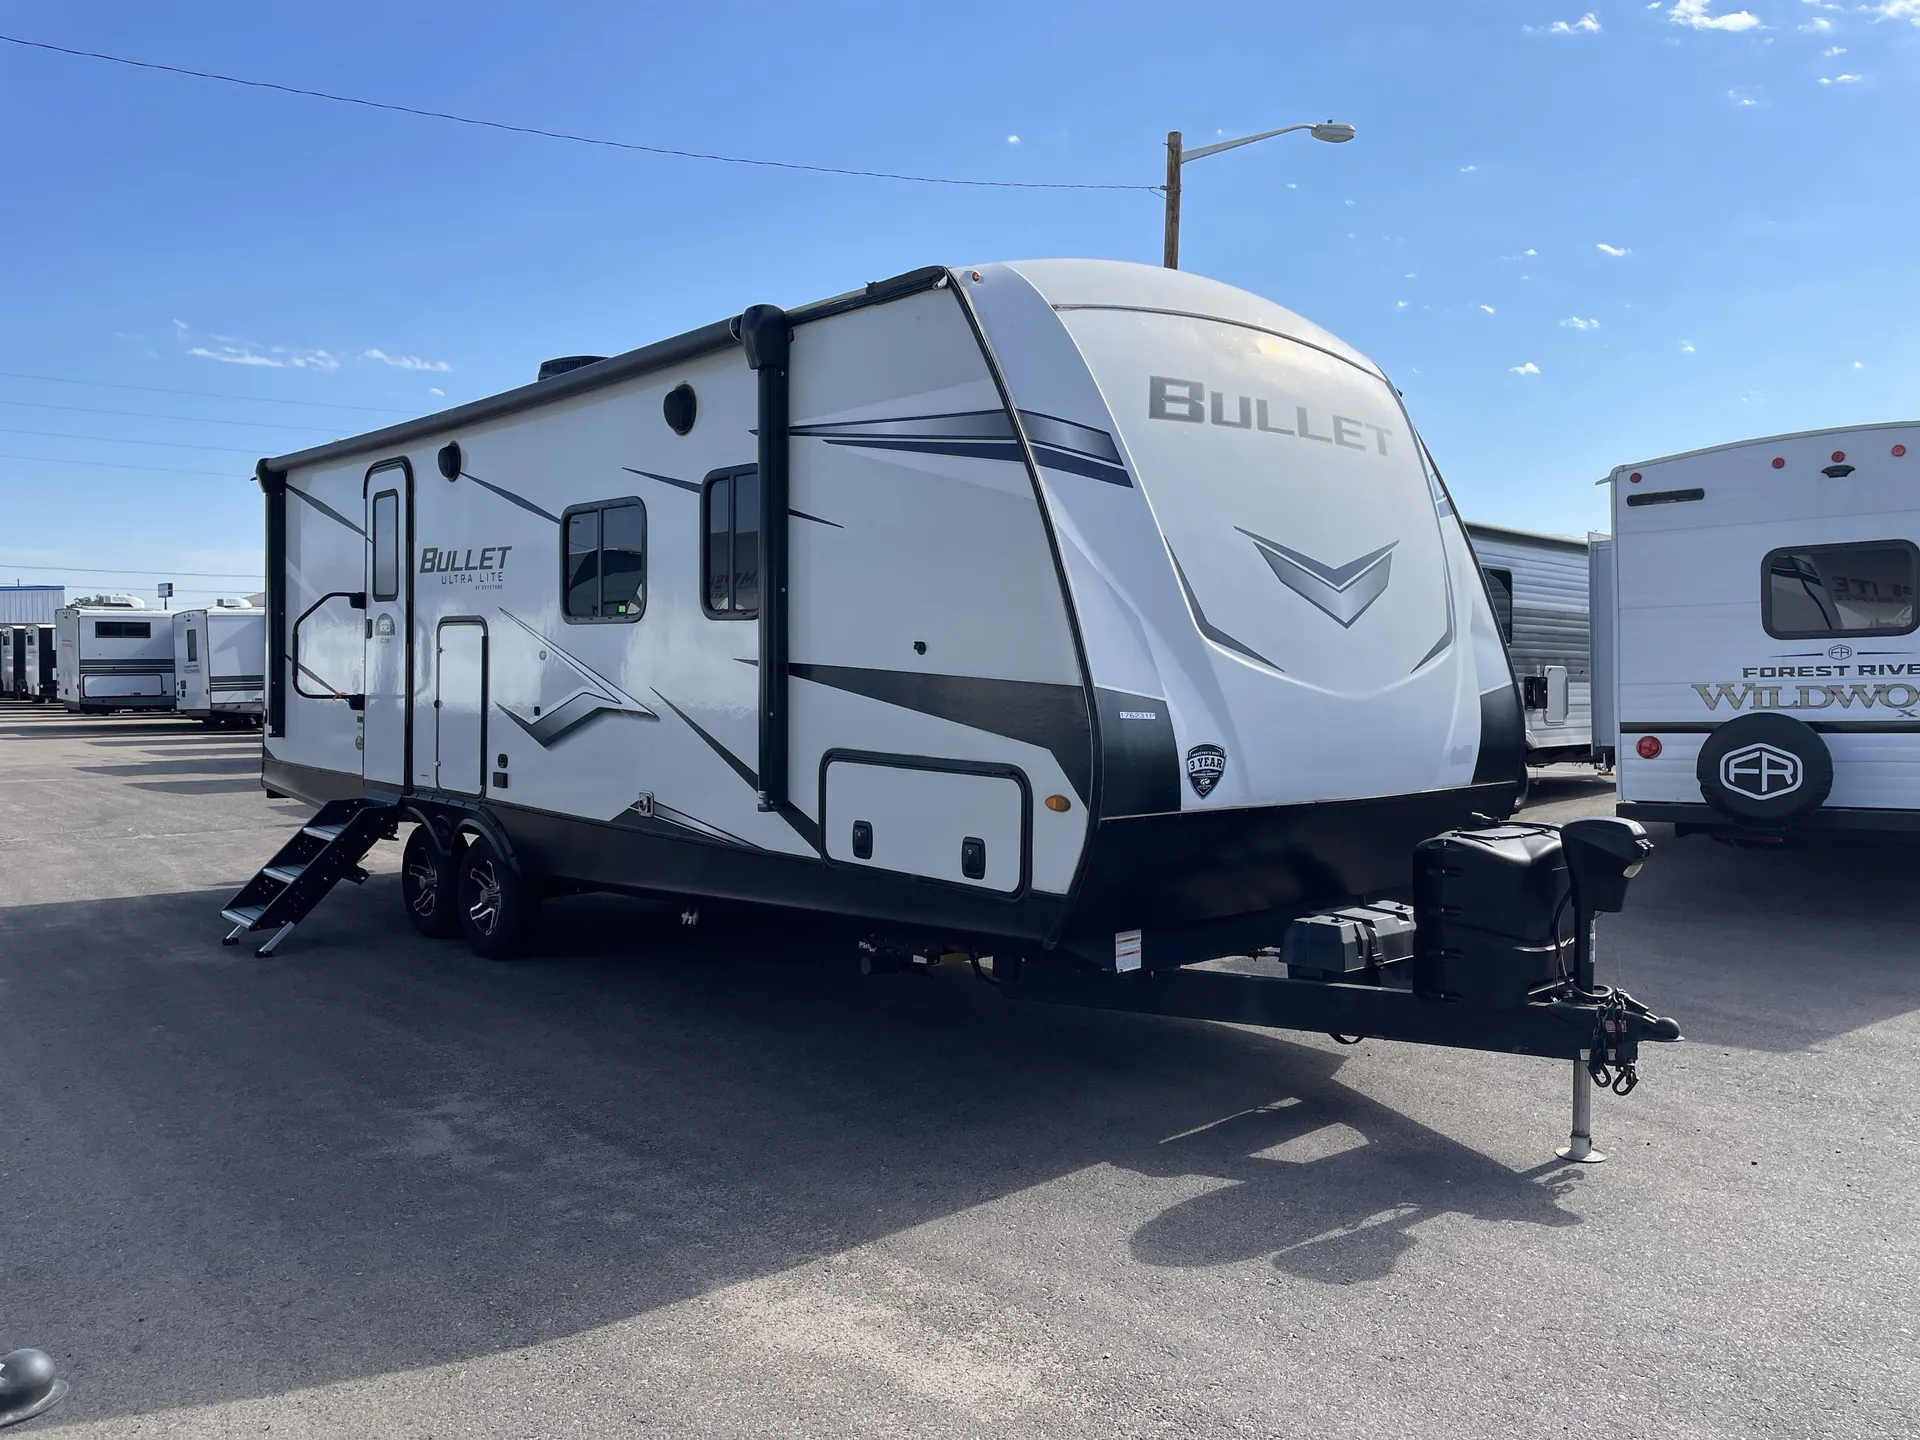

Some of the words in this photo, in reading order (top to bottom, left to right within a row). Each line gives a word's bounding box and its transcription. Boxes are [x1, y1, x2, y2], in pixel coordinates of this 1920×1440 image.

[1149, 375, 1393, 457] BULLET
[420, 546, 513, 573] BULLET
[441, 573, 473, 585] ULTRA
[479, 571, 504, 583] LITE
[1742, 665, 1851, 678] FOREST
[1691, 683, 1920, 711] WILDWO
[1189, 760, 1196, 771] 3
[1197, 757, 1223, 769] YEAR
